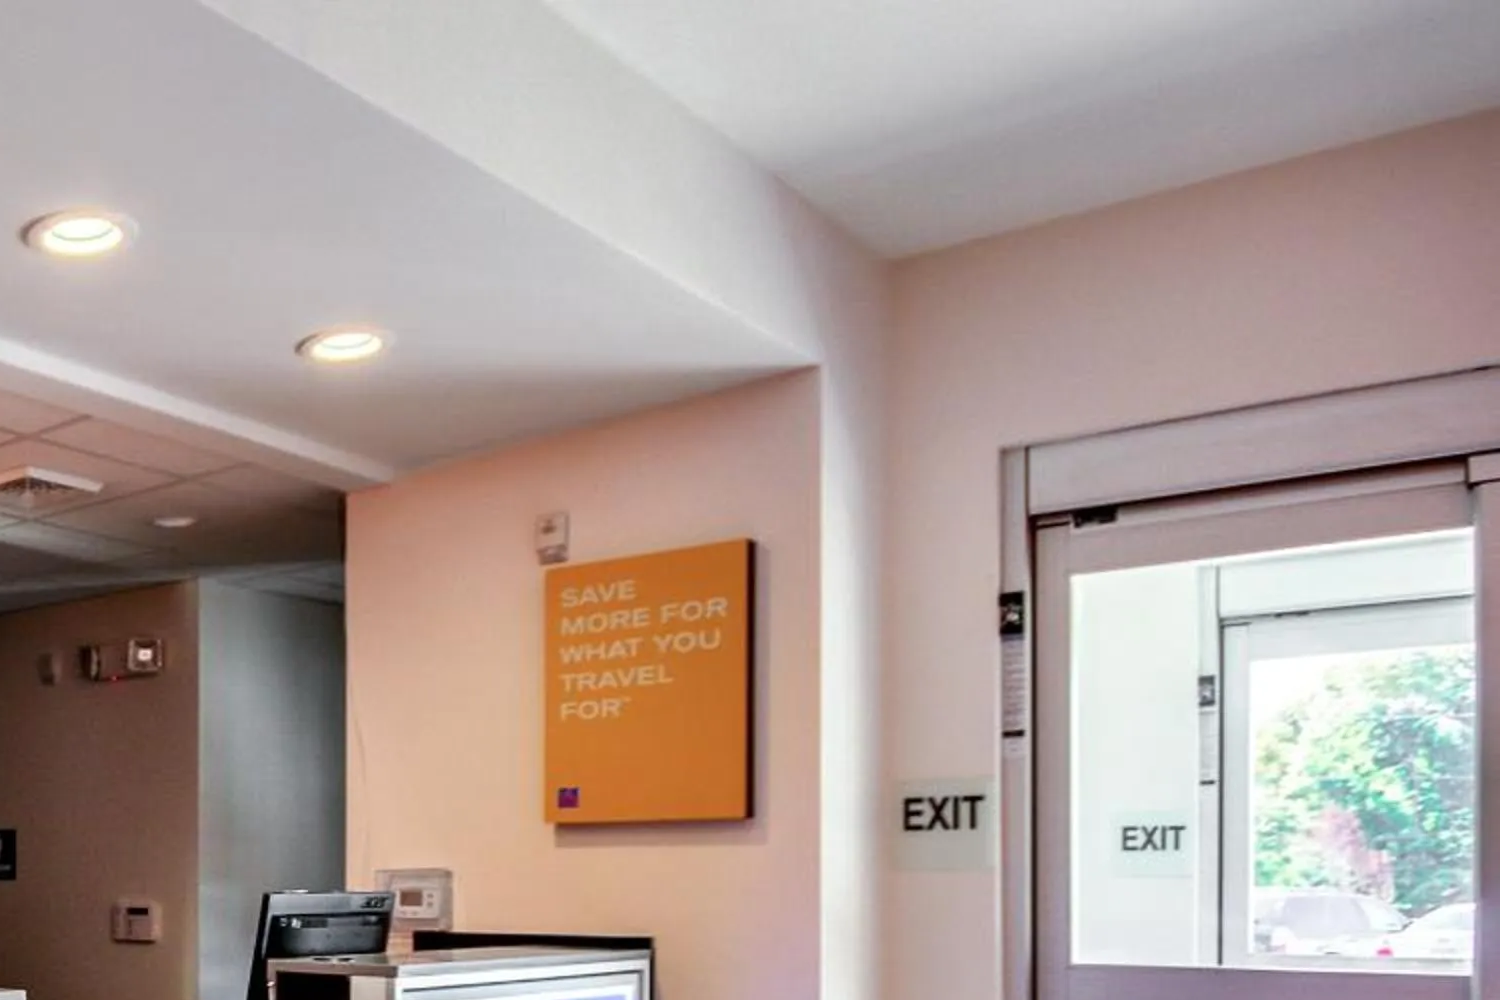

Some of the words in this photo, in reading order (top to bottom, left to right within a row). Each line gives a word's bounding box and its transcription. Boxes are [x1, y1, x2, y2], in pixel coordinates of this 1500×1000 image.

[561, 579, 636, 607] SAVE
[560, 607, 651, 637] MORE
[660, 596, 729, 624] FOR
[559, 637, 643, 664] WHAT
[653, 628, 722, 654] YOU
[559, 664, 674, 692] TRAVEL
[903, 795, 985, 831] EXIT
[1121, 825, 1186, 852] EXIT
